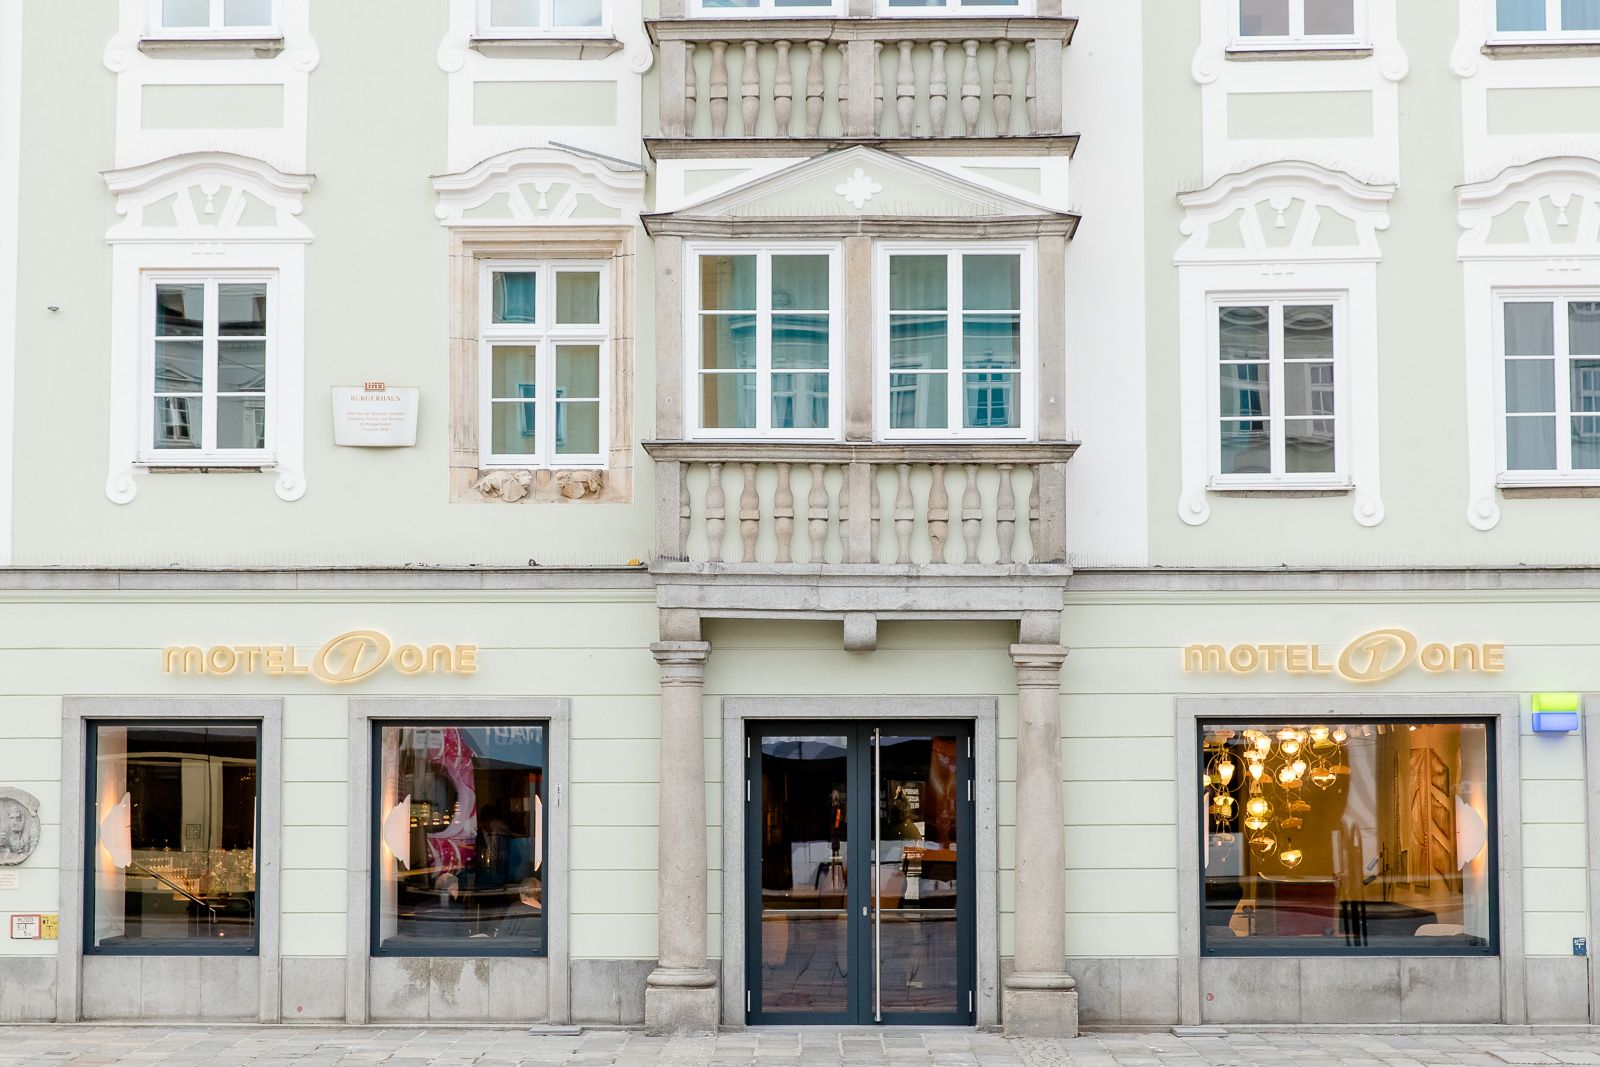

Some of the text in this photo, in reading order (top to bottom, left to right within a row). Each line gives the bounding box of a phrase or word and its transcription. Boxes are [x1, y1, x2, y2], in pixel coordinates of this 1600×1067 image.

[161, 645, 309, 674] MOTEL
[394, 644, 477, 672] ONE
[1184, 643, 1333, 672] MOTEL
[1420, 643, 1505, 672] ONE
